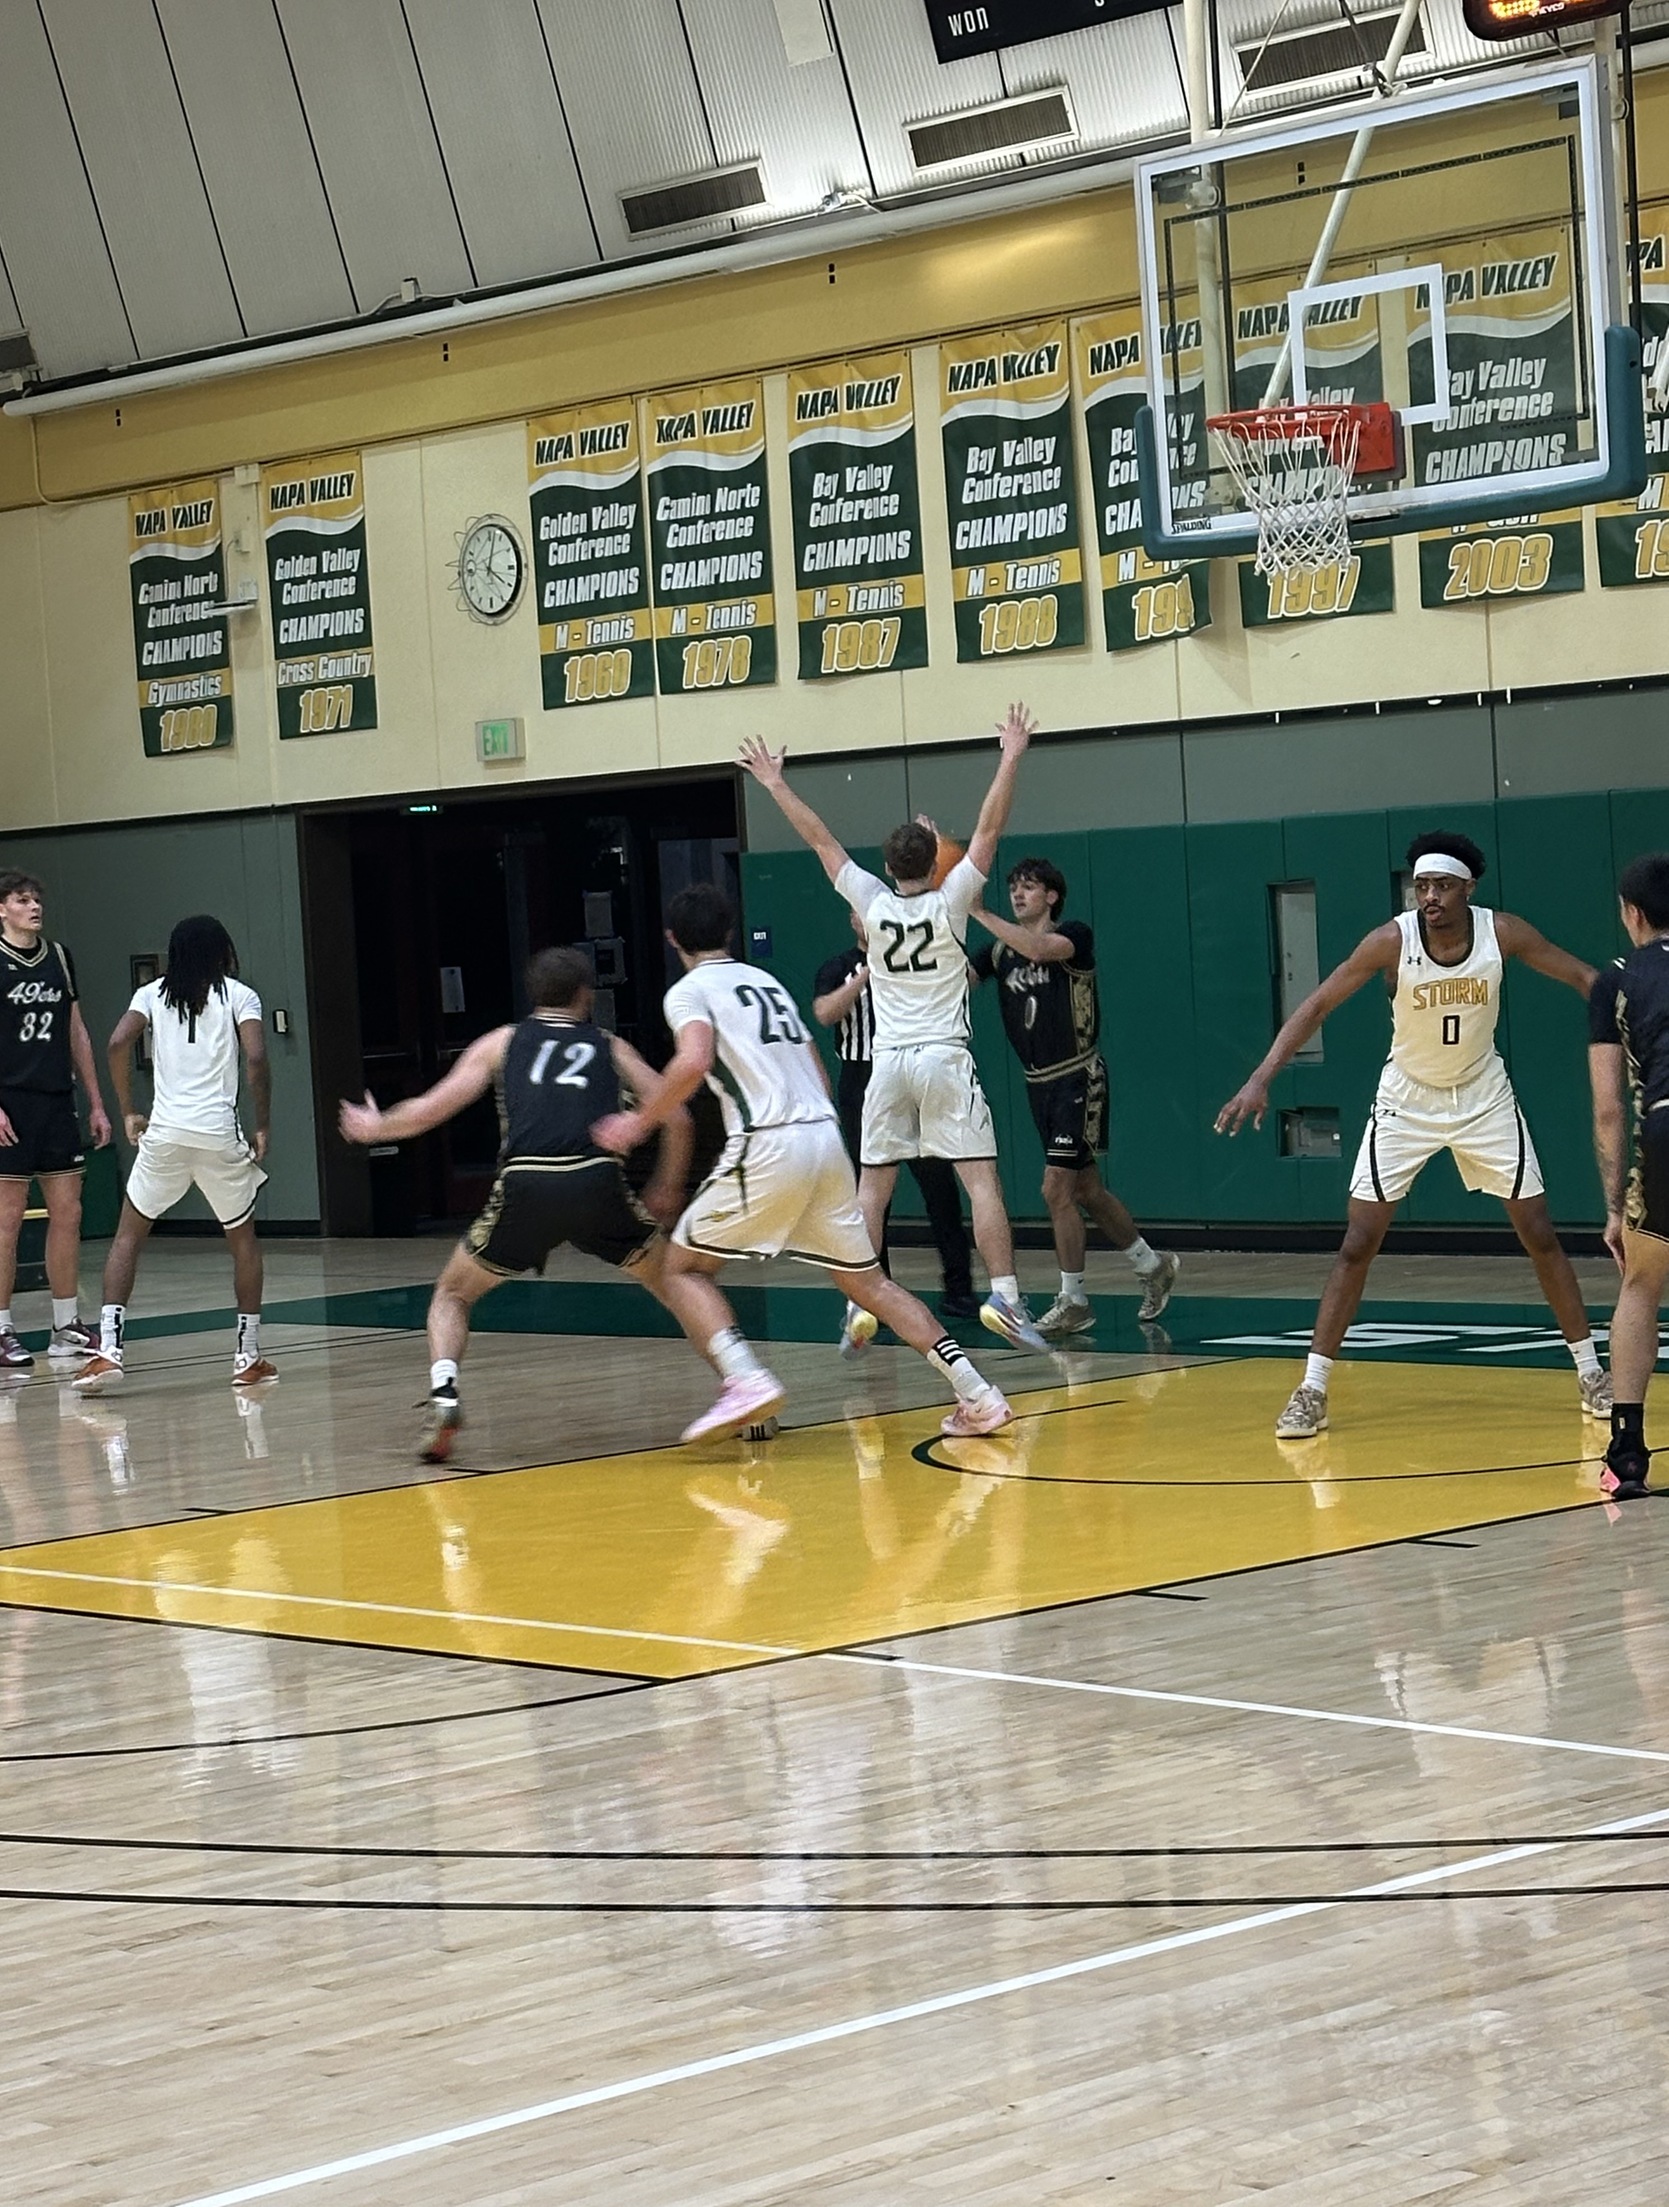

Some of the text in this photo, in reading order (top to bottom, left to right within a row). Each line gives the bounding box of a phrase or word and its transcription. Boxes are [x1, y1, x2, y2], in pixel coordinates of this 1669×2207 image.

[1481, 253, 1558, 298] VALLEY
[1306, 296, 1363, 327] ALLEY
[1089, 333, 1140, 376] NAPA
[947, 358, 997, 394] NAPA
[1479, 356, 1547, 391] Valley
[702, 401, 754, 433] VALLEY
[796, 388, 839, 421] NAPA
[535, 423, 630, 466] NAPA VALLEY
[966, 436, 1057, 475] Bay Valley
[1425, 433, 1566, 484] CHAMPIONS
[270, 471, 355, 511] NAPA VALLEY
[715, 484, 760, 512] Norte
[812, 464, 893, 500] Bay Valley
[962, 466, 1062, 505] Conference
[172, 499, 214, 529] VALLEY
[540, 503, 637, 541] Golden Valley
[809, 494, 900, 528] Conference
[955, 503, 1067, 551] CHAMPIONS
[1171, 518, 1212, 535] SPALDING
[548, 533, 631, 566] Conference
[666, 515, 754, 548] Conference
[1635, 519, 1669, 579] 19
[275, 547, 360, 581] Golden Valley
[803, 531, 911, 573] CHAMPIONS
[1118, 551, 1136, 582] M
[1443, 533, 1554, 601] 2003
[544, 567, 640, 608] CHAMPIONS
[660, 551, 763, 591] CHAMPIONS
[966, 568, 985, 598] M
[1005, 557, 1061, 592] Tennis
[282, 576, 356, 605] Conference
[813, 589, 828, 618] M
[847, 581, 905, 614] Tennis
[279, 608, 364, 644] CHAMPIONS
[555, 624, 569, 650] M
[585, 616, 634, 645] Tennis
[671, 608, 688, 635] M
[705, 601, 757, 631] Tennis
[979, 594, 1058, 655] 1988
[682, 635, 752, 689] 1978
[821, 617, 901, 674] 1987
[278, 652, 372, 685] Cross Country
[564, 649, 632, 703] 1960
[148, 675, 222, 707] Gymnastics
[300, 686, 353, 733] 1971
[880, 918, 938, 973] 22
[1412, 977, 1488, 1011] STORM
[735, 984, 803, 1045] 25
[1442, 1015, 1460, 1045] 0
[529, 1039, 598, 1089] 12
